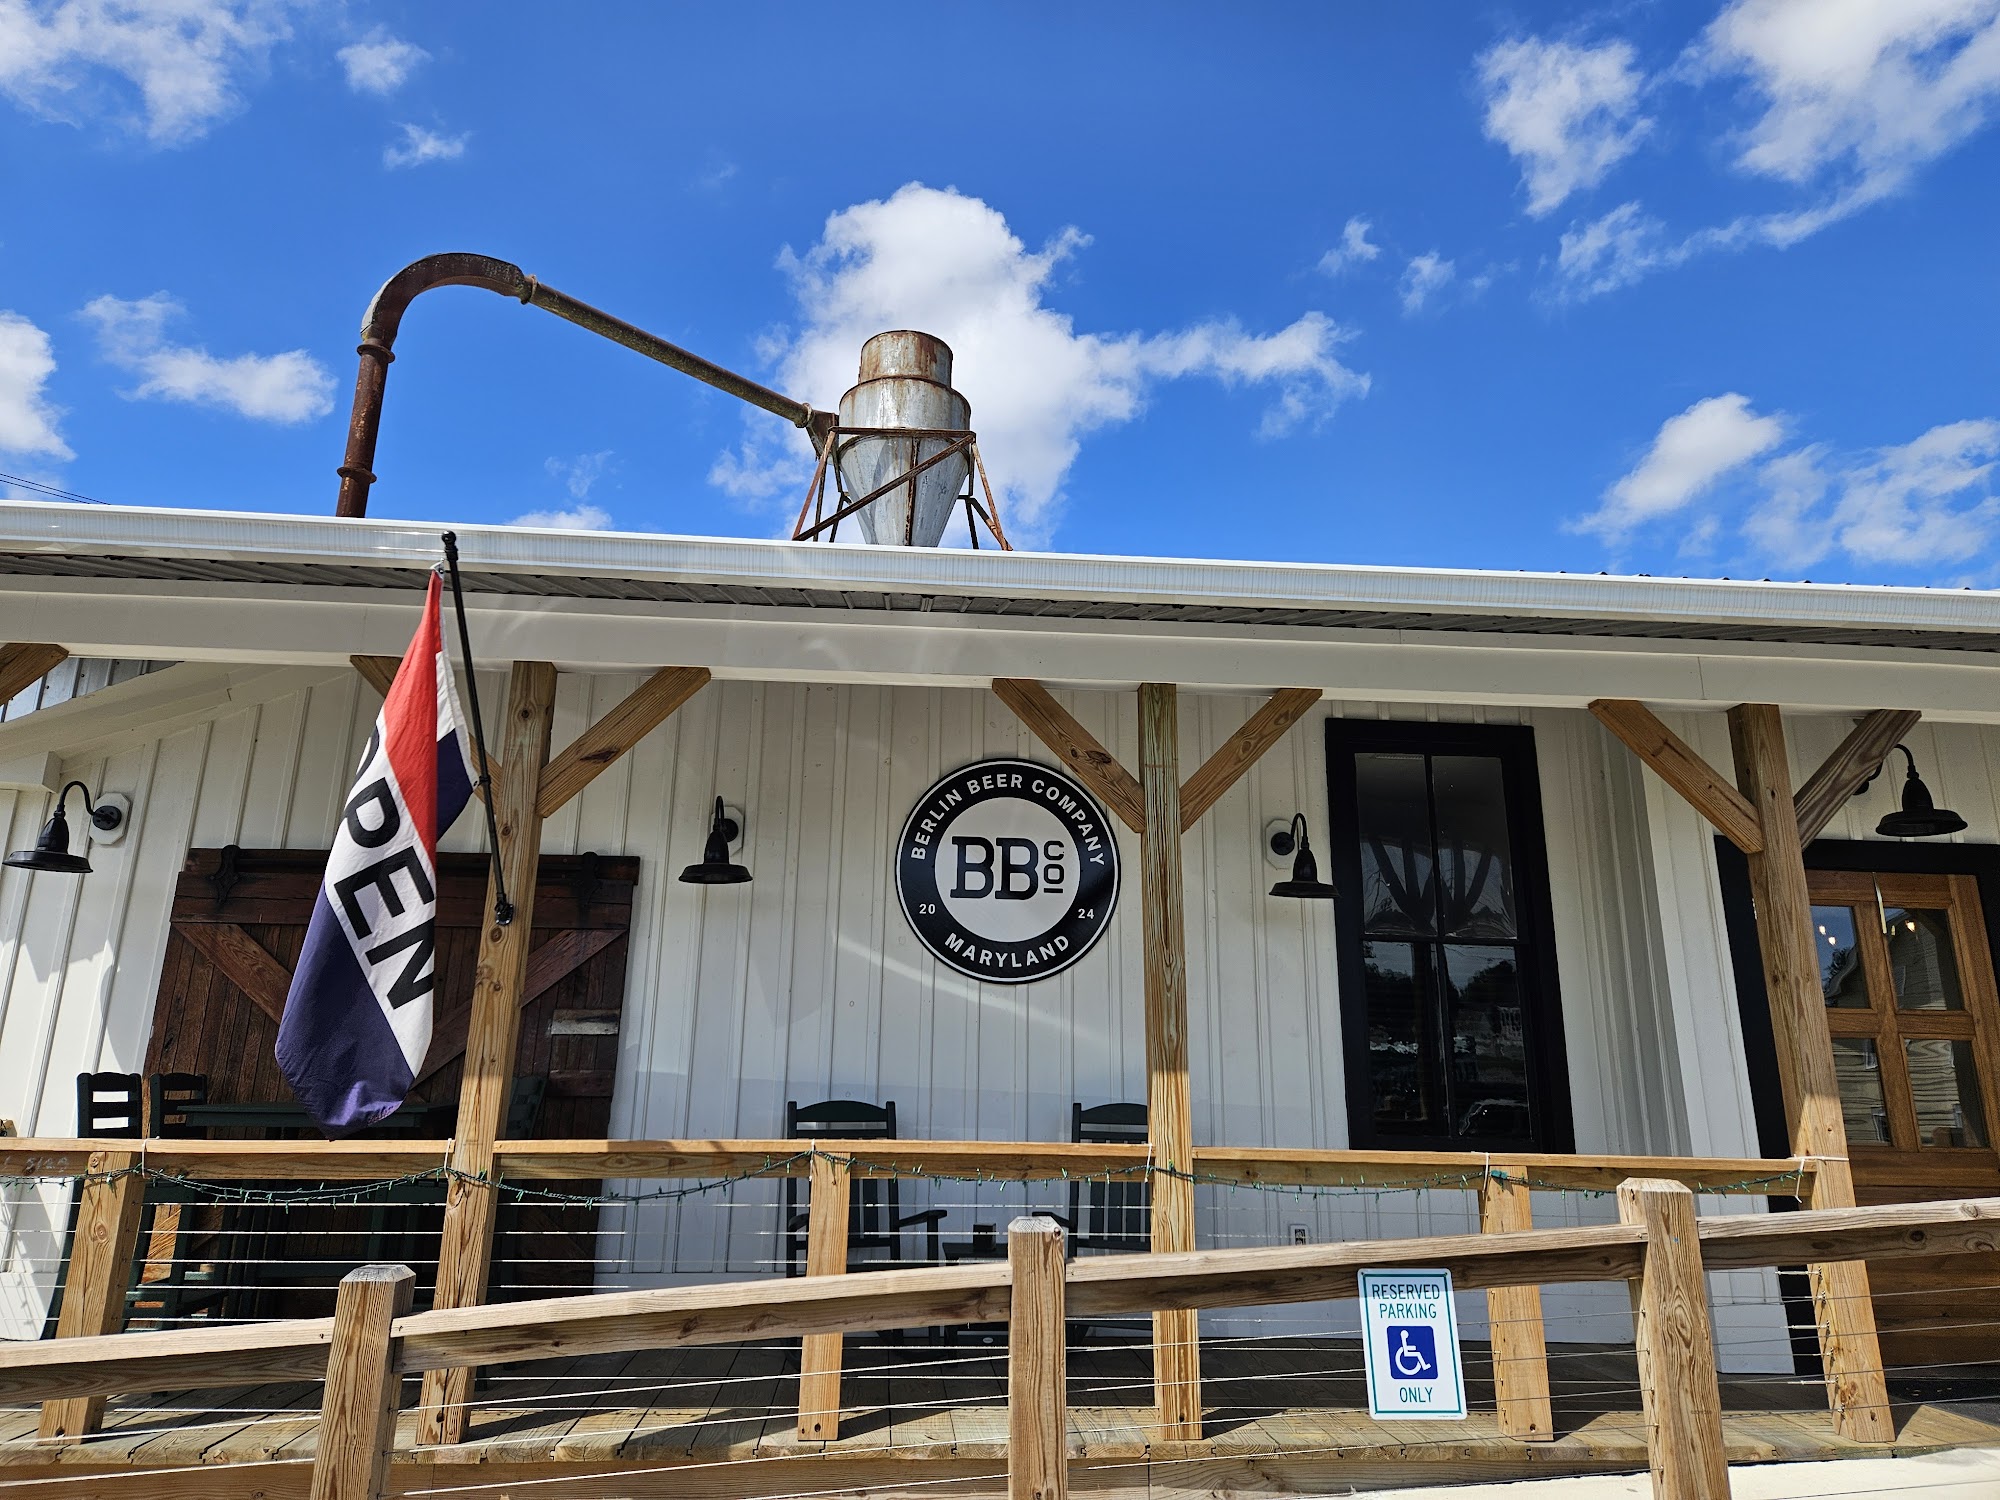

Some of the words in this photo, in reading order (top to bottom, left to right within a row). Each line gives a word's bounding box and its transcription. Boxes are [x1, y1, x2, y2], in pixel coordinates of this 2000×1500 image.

[911, 789, 963, 860] BERLIN
[966, 774, 1023, 795] BEER
[1031, 779, 1105, 866] COMPANY
[950, 836, 1039, 901] BB
[919, 903, 936, 915] 20
[1078, 908, 1095, 920] 24
[944, 932, 1069, 968] MARYLAND
[1372, 1284, 1440, 1300] RESERVED
[1379, 1303, 1437, 1319] PARKING
[1399, 1387, 1433, 1403] ONLY
